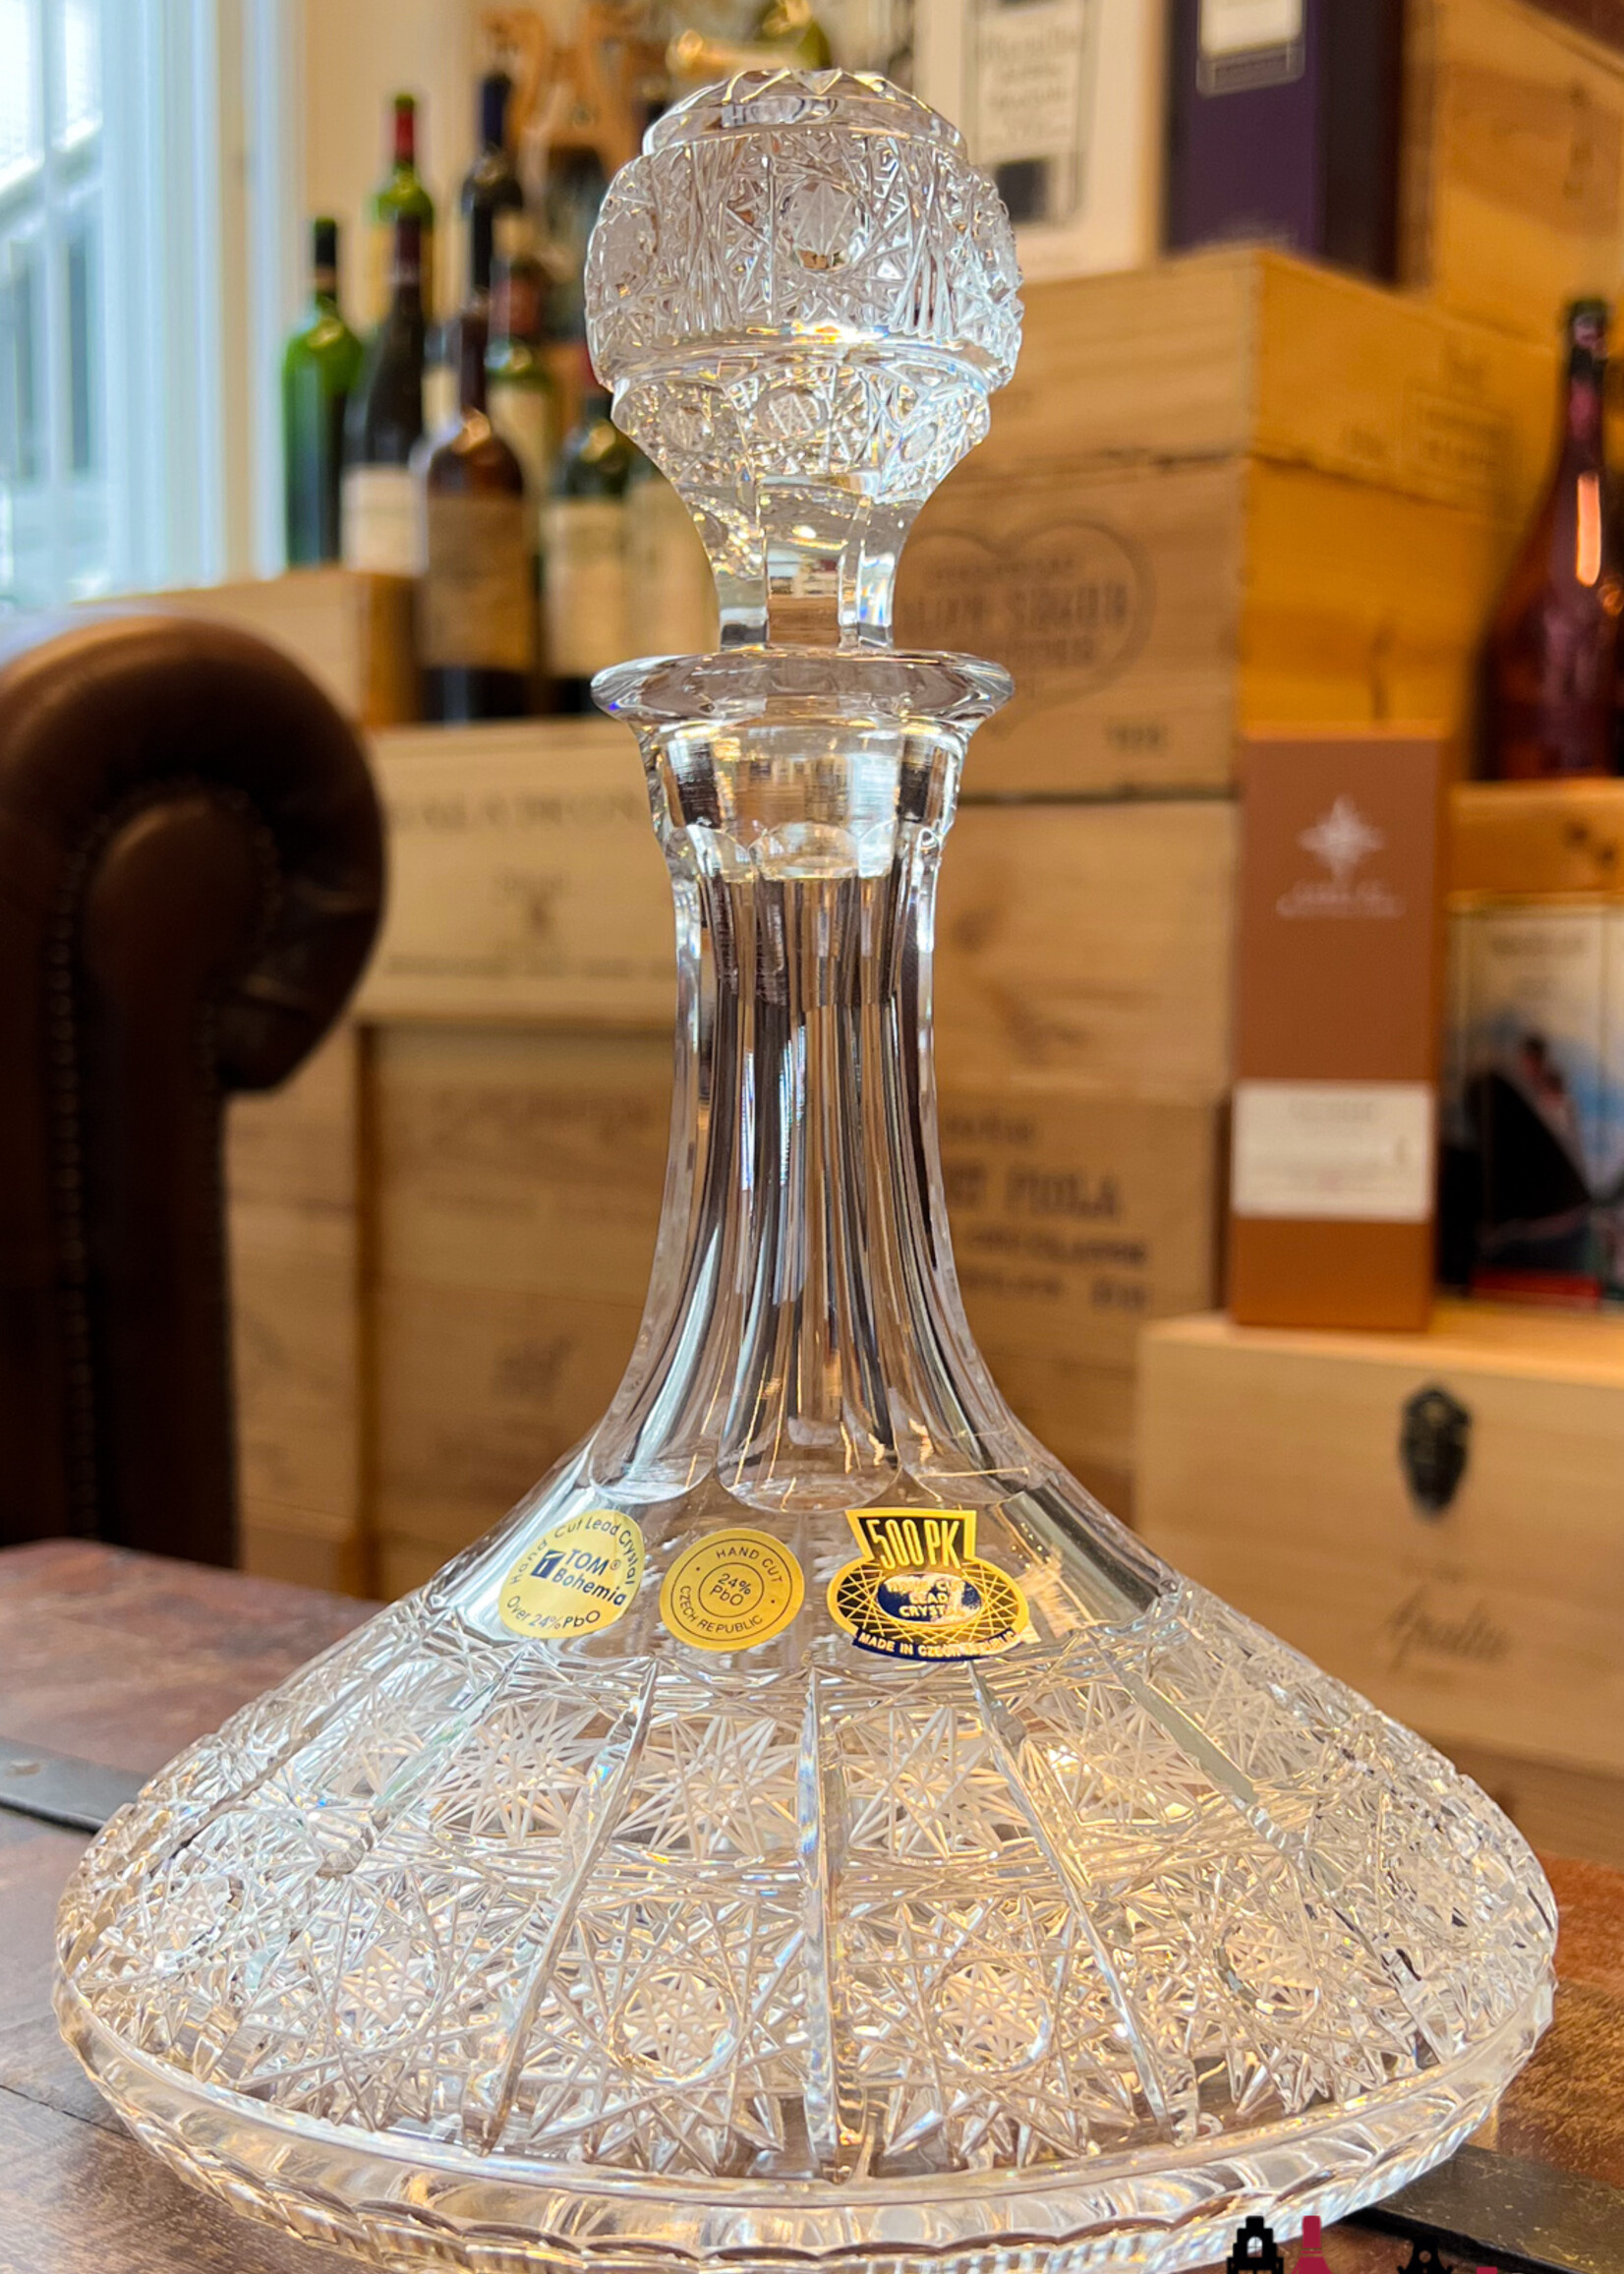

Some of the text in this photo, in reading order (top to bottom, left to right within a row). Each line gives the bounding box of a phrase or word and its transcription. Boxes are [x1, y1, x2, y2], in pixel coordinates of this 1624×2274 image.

[510, 1516, 639, 1585] Hand Cut Lead Crystal
[865, 1518, 962, 1570] 500 PK
[716, 1546, 783, 1583] HAND CUT
[551, 1568, 627, 1606] Bohemia
[709, 1584, 744, 1606] PbO
[718, 1573, 751, 1596] 24%
[909, 1593, 949, 1604] LEAD
[506, 1596, 601, 1630] Over 24% PbO
[679, 1585, 763, 1634] CZECH REPUBLIC
[858, 1631, 896, 1653] MADE
[899, 1644, 914, 1656] IN
